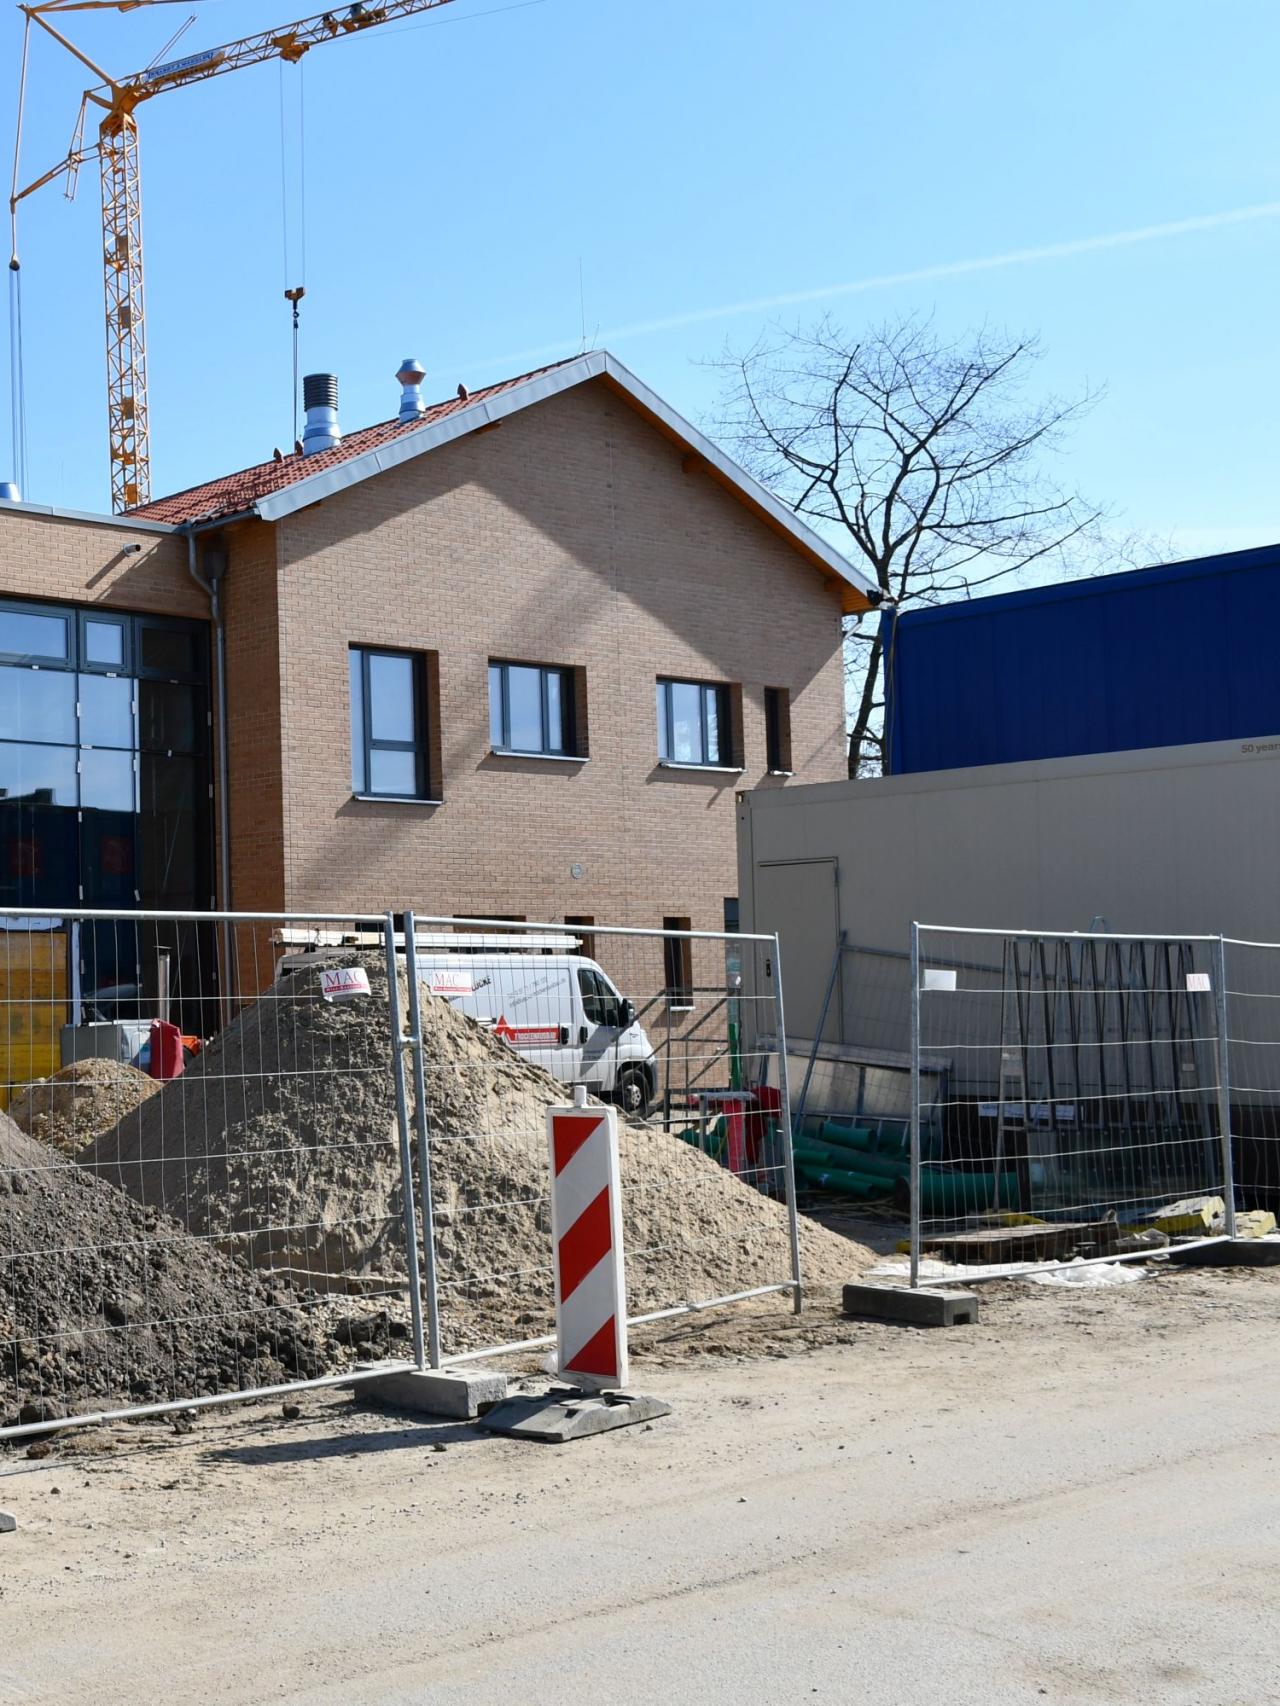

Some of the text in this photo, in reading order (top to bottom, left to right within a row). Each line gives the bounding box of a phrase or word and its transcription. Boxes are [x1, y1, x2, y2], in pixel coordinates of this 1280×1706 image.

[1241, 744, 1254, 753] 50
[323, 970, 363, 987] MAC
[433, 972, 460, 986] MAC
